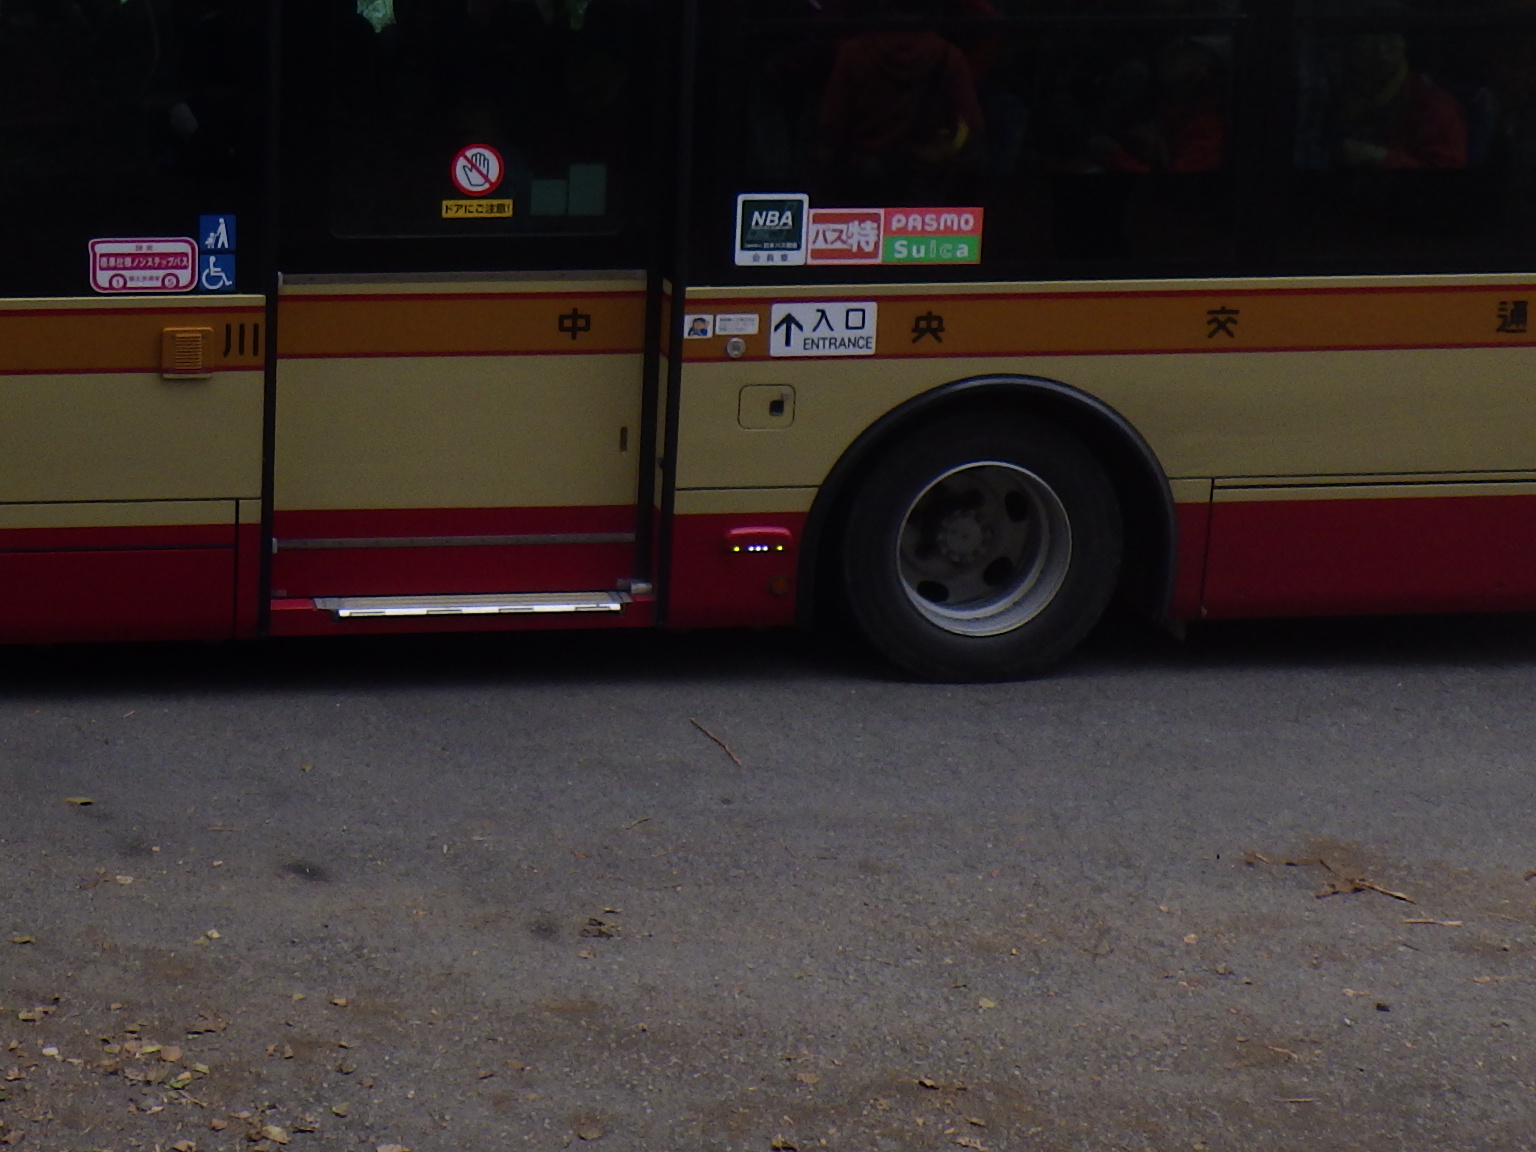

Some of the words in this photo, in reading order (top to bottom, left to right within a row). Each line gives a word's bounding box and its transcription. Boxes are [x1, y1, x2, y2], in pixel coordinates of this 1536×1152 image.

[751, 210, 794, 228] NBA
[891, 213, 975, 232] PASMO
[894, 239, 969, 259] Suica
[812, 308, 866, 332] 入口
[803, 336, 873, 350] ENTRANCE
